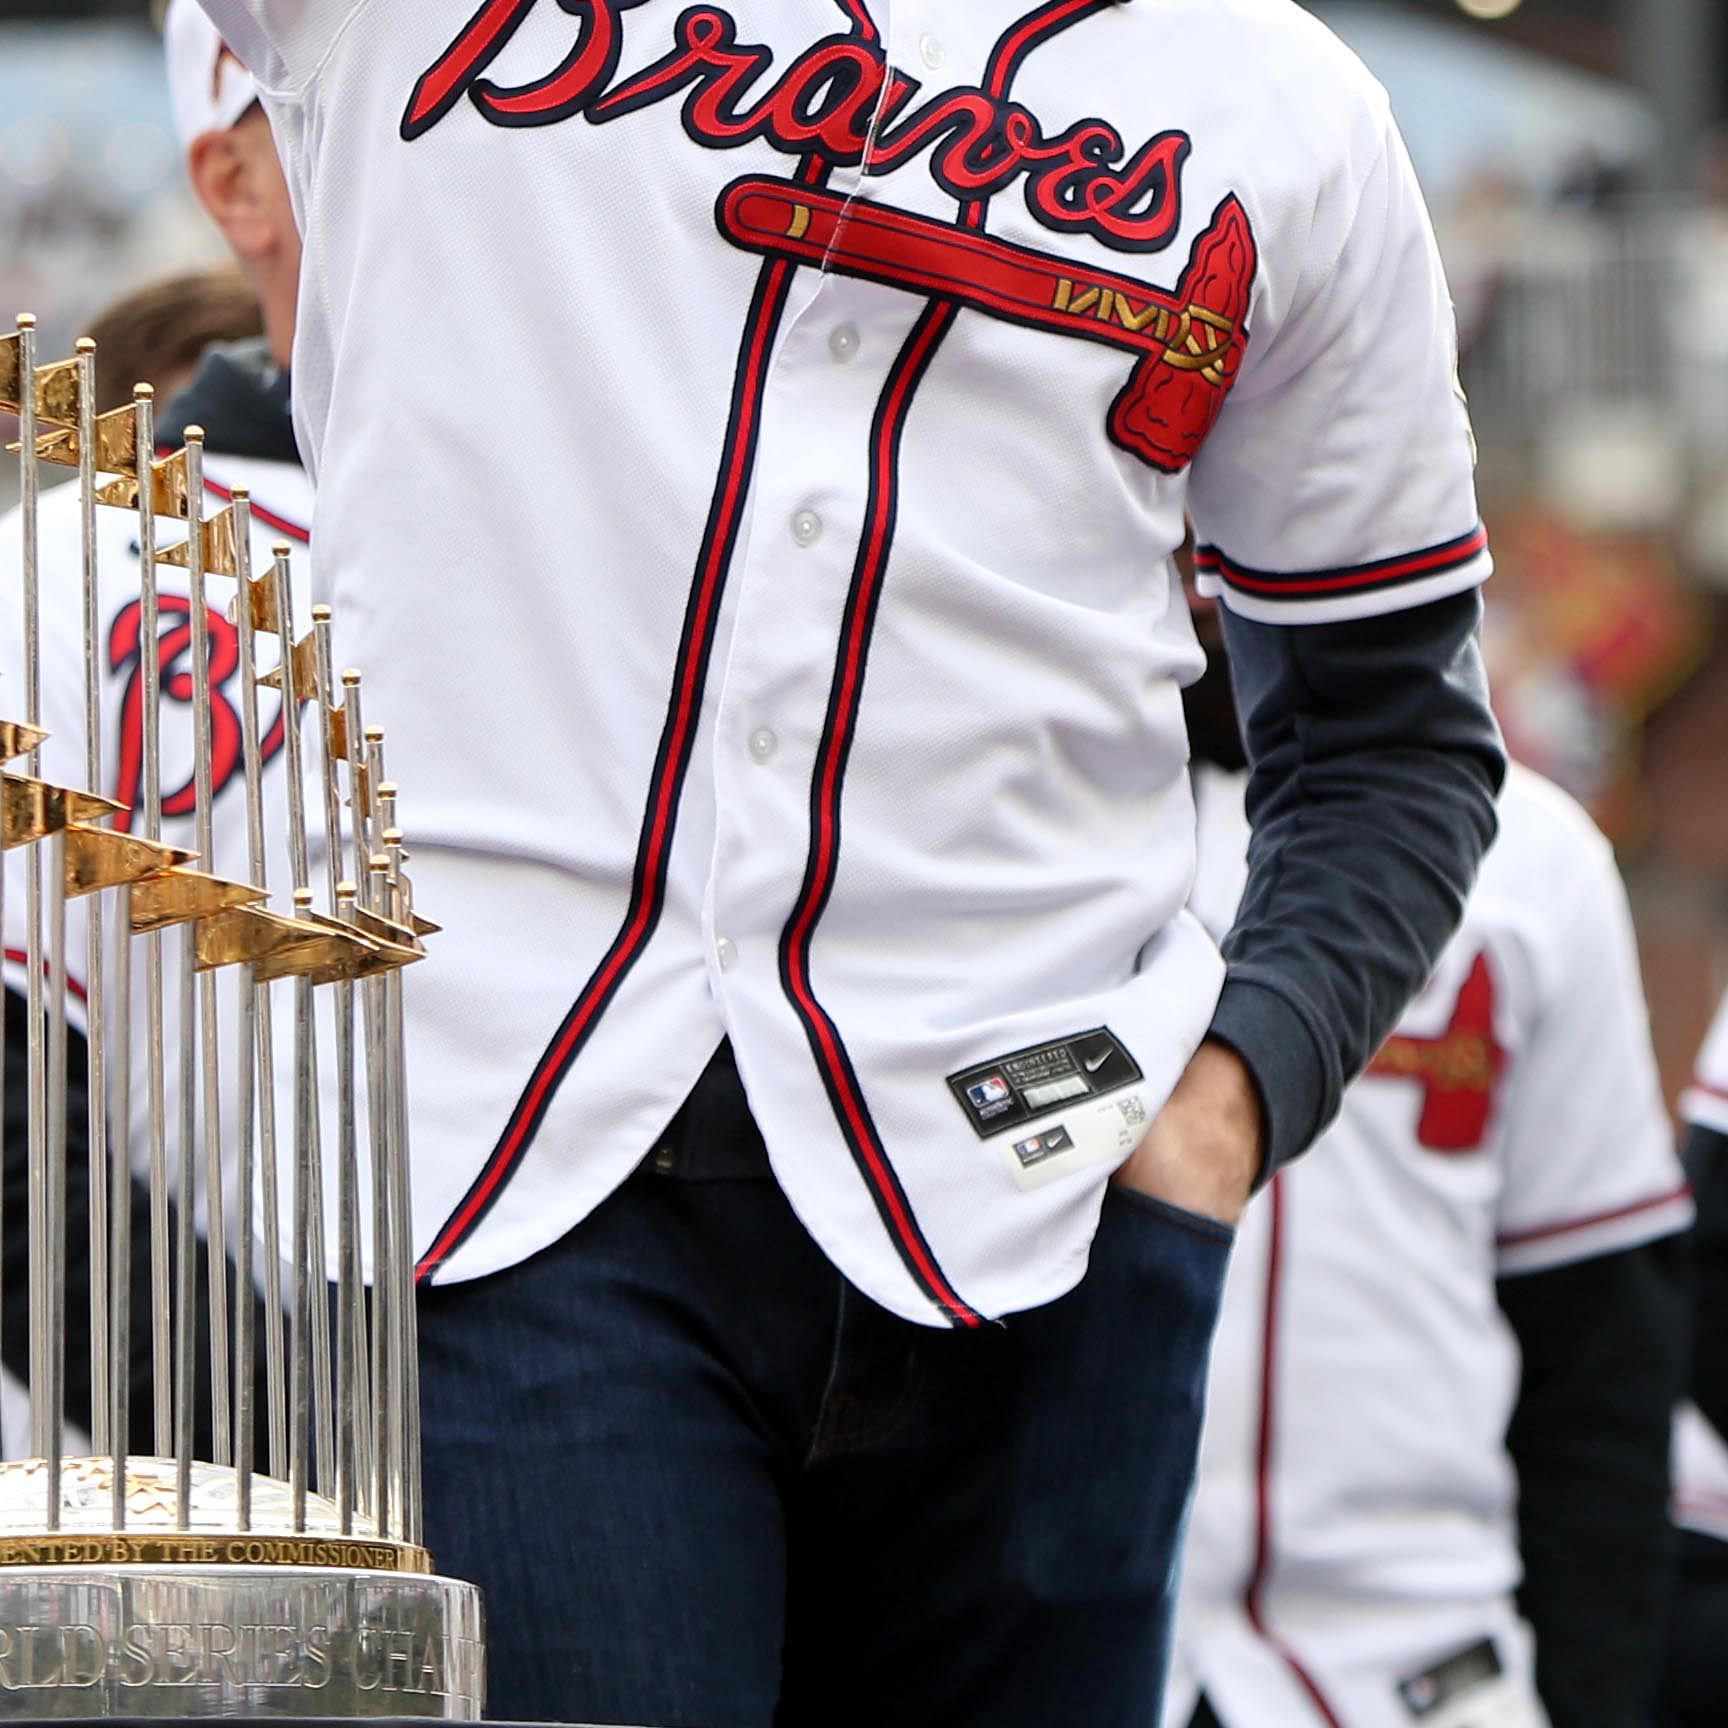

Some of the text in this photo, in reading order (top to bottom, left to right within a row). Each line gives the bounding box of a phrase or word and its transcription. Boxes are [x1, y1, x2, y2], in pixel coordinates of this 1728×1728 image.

[112, 1537, 145, 1563] BY
[160, 1540, 223, 1563] THE
[227, 1541, 397, 1570] COMMISSIONER
[121, 1623, 334, 1690] SERIES
